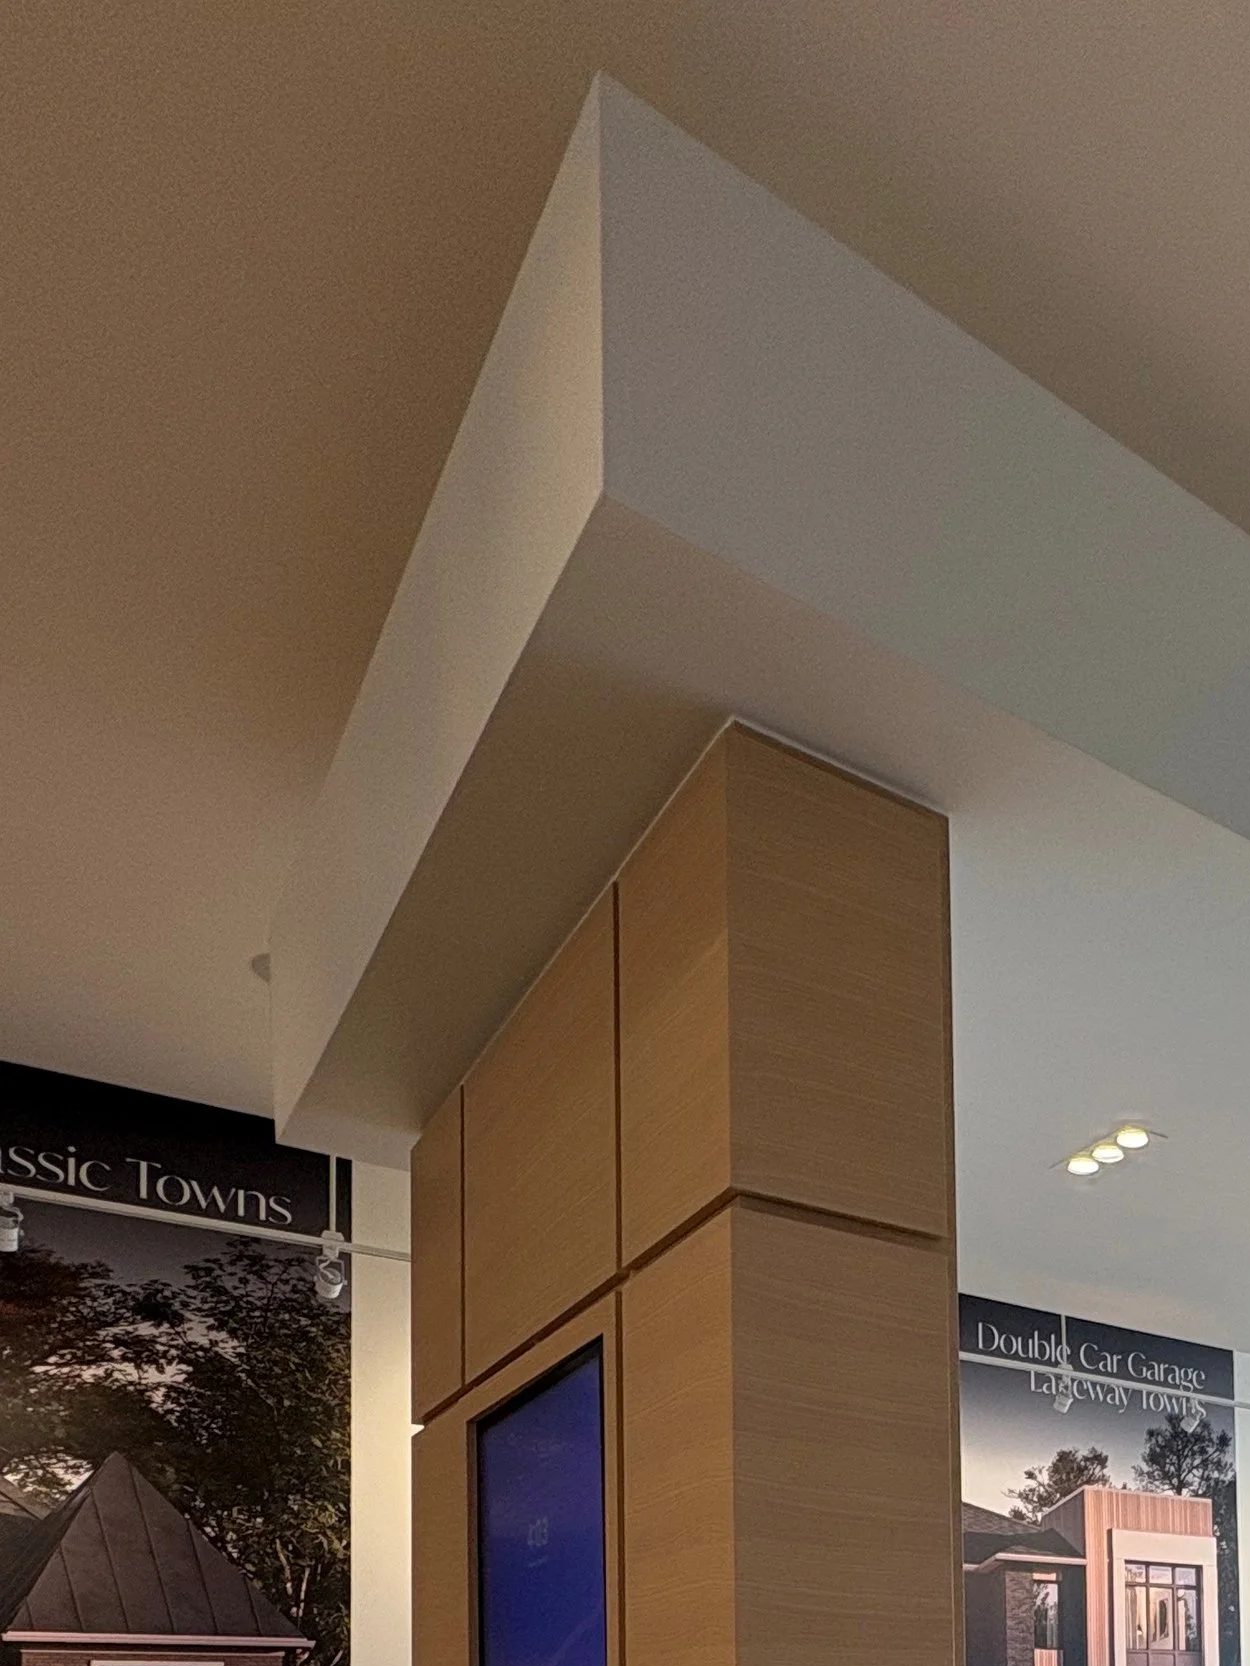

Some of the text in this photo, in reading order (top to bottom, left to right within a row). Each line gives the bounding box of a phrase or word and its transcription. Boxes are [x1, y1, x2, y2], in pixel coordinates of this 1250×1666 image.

[0, 1145, 293, 1226] ssic Towns
[977, 1321, 1206, 1393] Double Car Garage
[1030, 1369, 1132, 1413] Laeway
